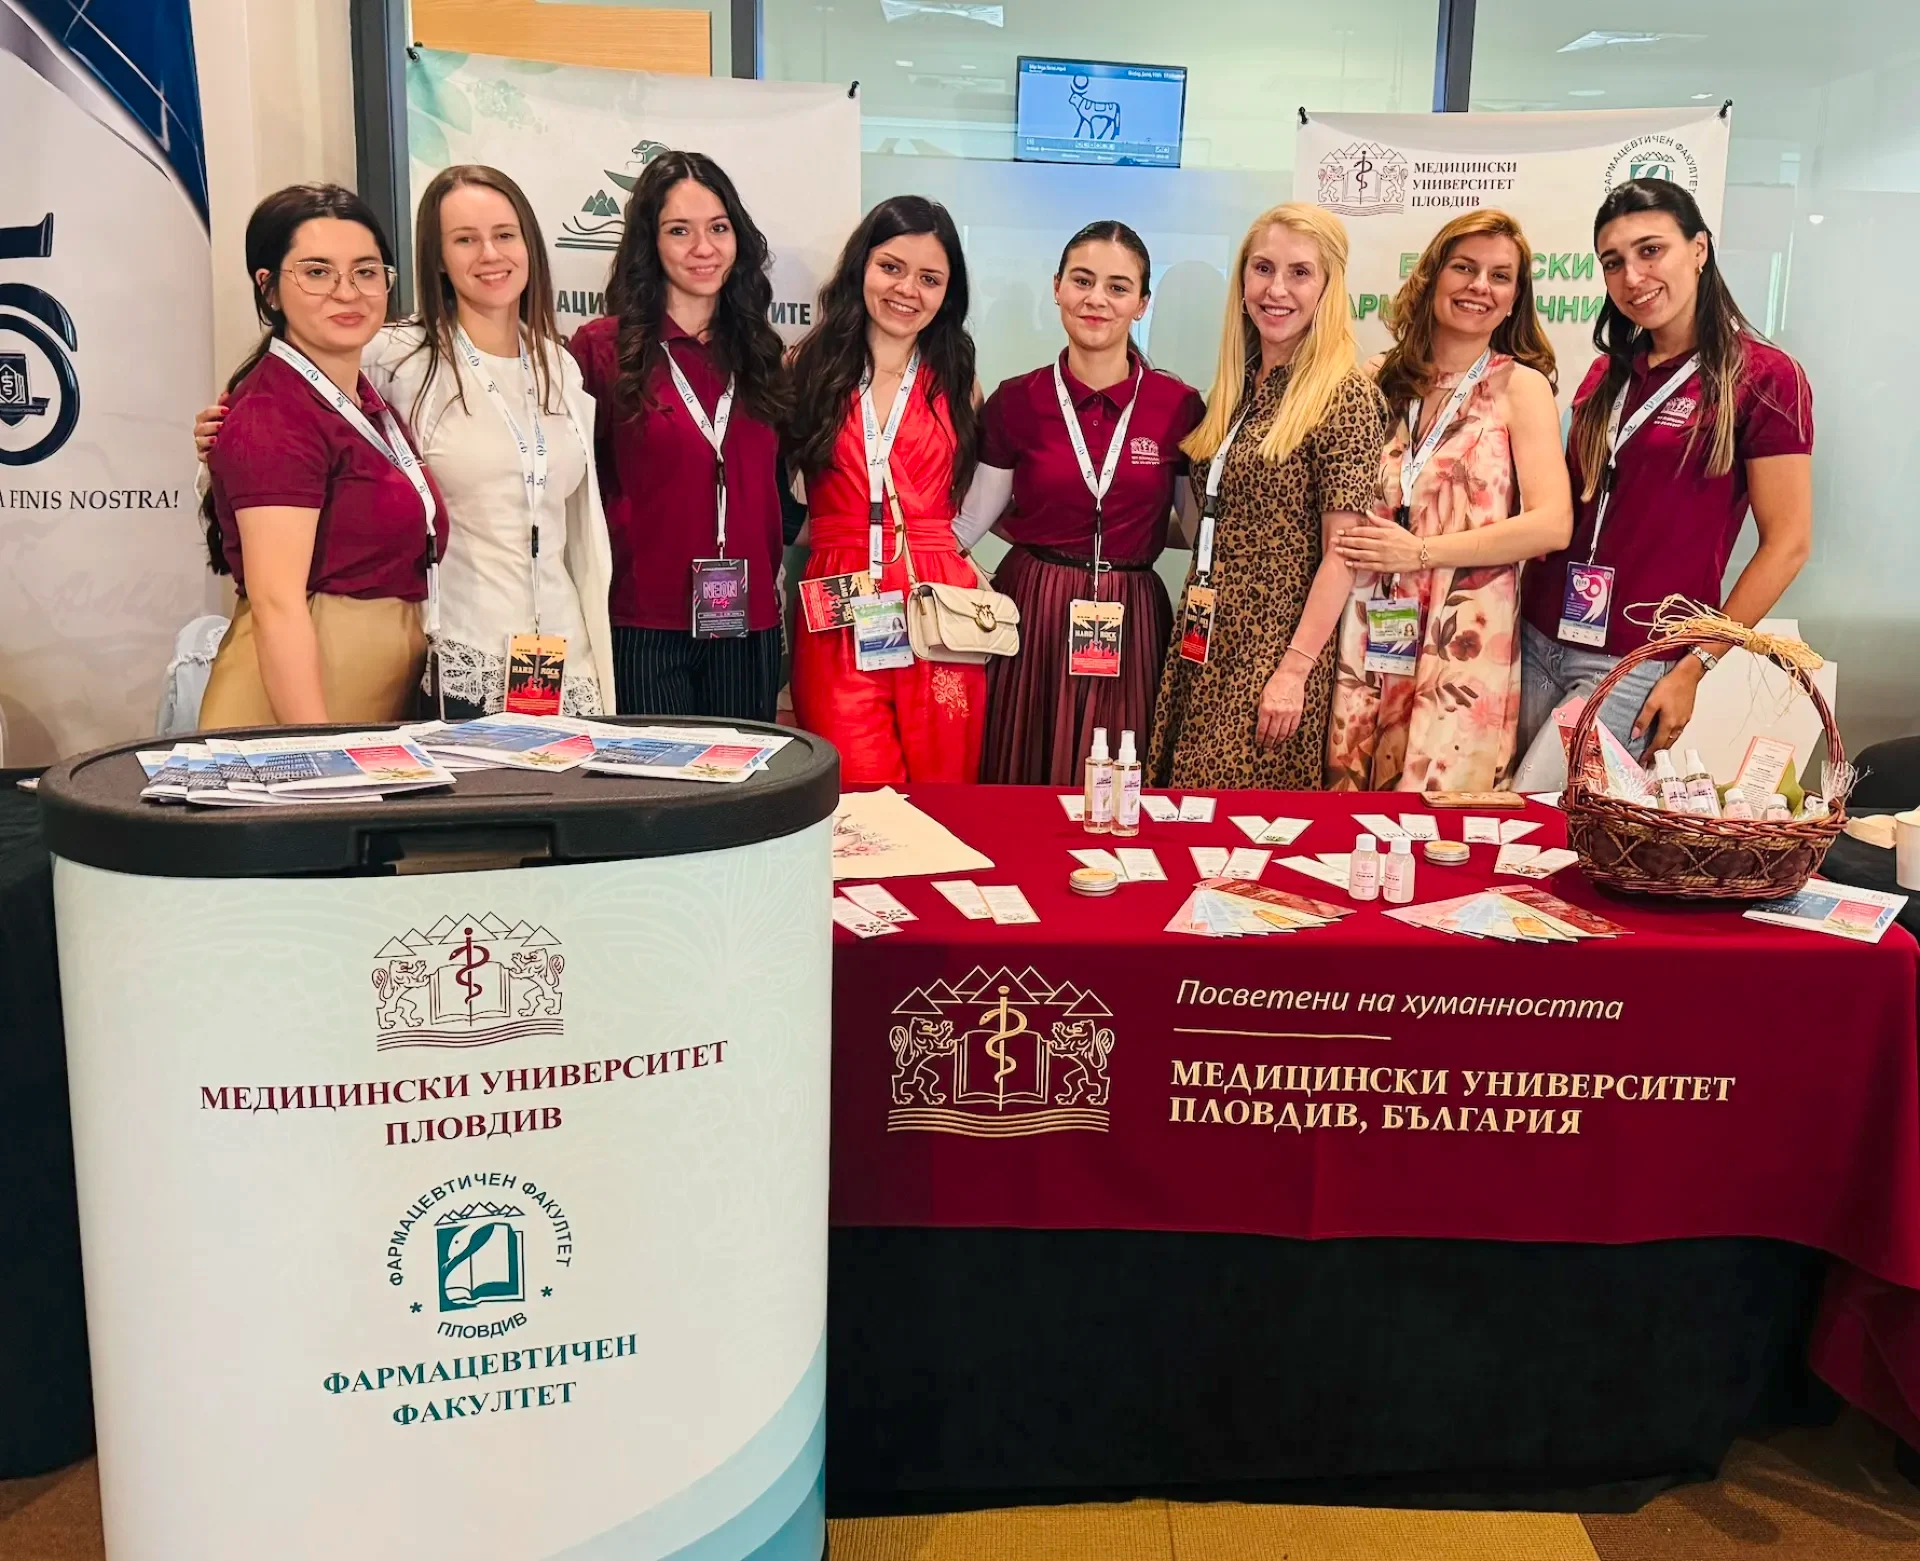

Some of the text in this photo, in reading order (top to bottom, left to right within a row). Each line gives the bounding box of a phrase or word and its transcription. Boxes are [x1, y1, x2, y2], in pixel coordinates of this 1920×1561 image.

[1411, 178, 1515, 191] УНИВЕРСИТЕТ
[1413, 161, 1517, 175] МЕДИЦИНСКИ
[1411, 195, 1480, 208] ПЛОВДИВ
[9, 489, 63, 510] FINIS
[69, 489, 179, 510] NOSTRA!
[703, 580, 738, 599] NEON
[1176, 979, 1624, 1021] Посветени на хуманността
[200, 1039, 728, 1114] МЕДИЦИНСКИ УНИВЕРСИТЕТ
[1170, 1059, 1736, 1102] МЕДИЦИНСКИ УНИВЕРСИТЕТ
[385, 1106, 562, 1146] ПЛОВДИВ
[1168, 1096, 1583, 1135] ПЛОВДИВ, БЪЛГАРИЯ
[386, 1172, 573, 1287] ФАРМАЦЕВТИЧЕН ФАКУЛТЕТ
[436, 1311, 528, 1339] ПЛОВДИВ
[323, 1333, 638, 1395] ФАРМАЦЕВТИЧЕН
[392, 1381, 577, 1426] ФАКУЛТЕТ
